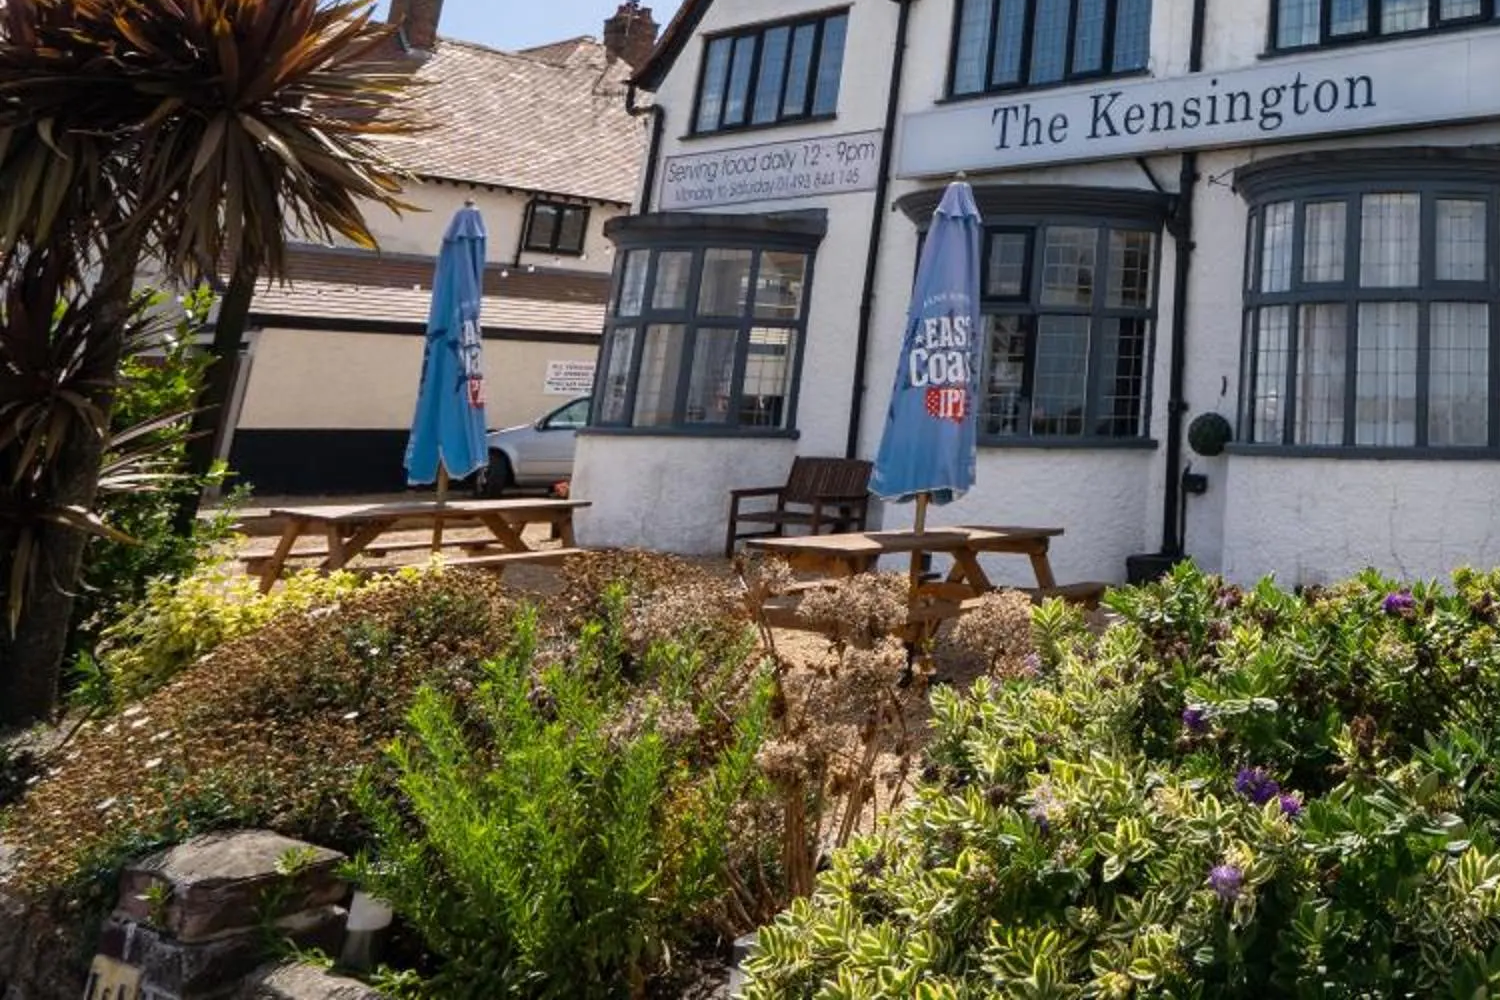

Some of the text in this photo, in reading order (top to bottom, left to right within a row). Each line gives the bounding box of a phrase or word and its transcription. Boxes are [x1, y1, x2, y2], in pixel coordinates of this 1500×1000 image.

[991, 73, 1378, 150] The Kensington
[667, 161, 719, 183] Serving
[722, 153, 757, 176] food
[760, 148, 797, 173] daily
[803, 143, 821, 167] 12
[837, 140, 877, 167] 9pm
